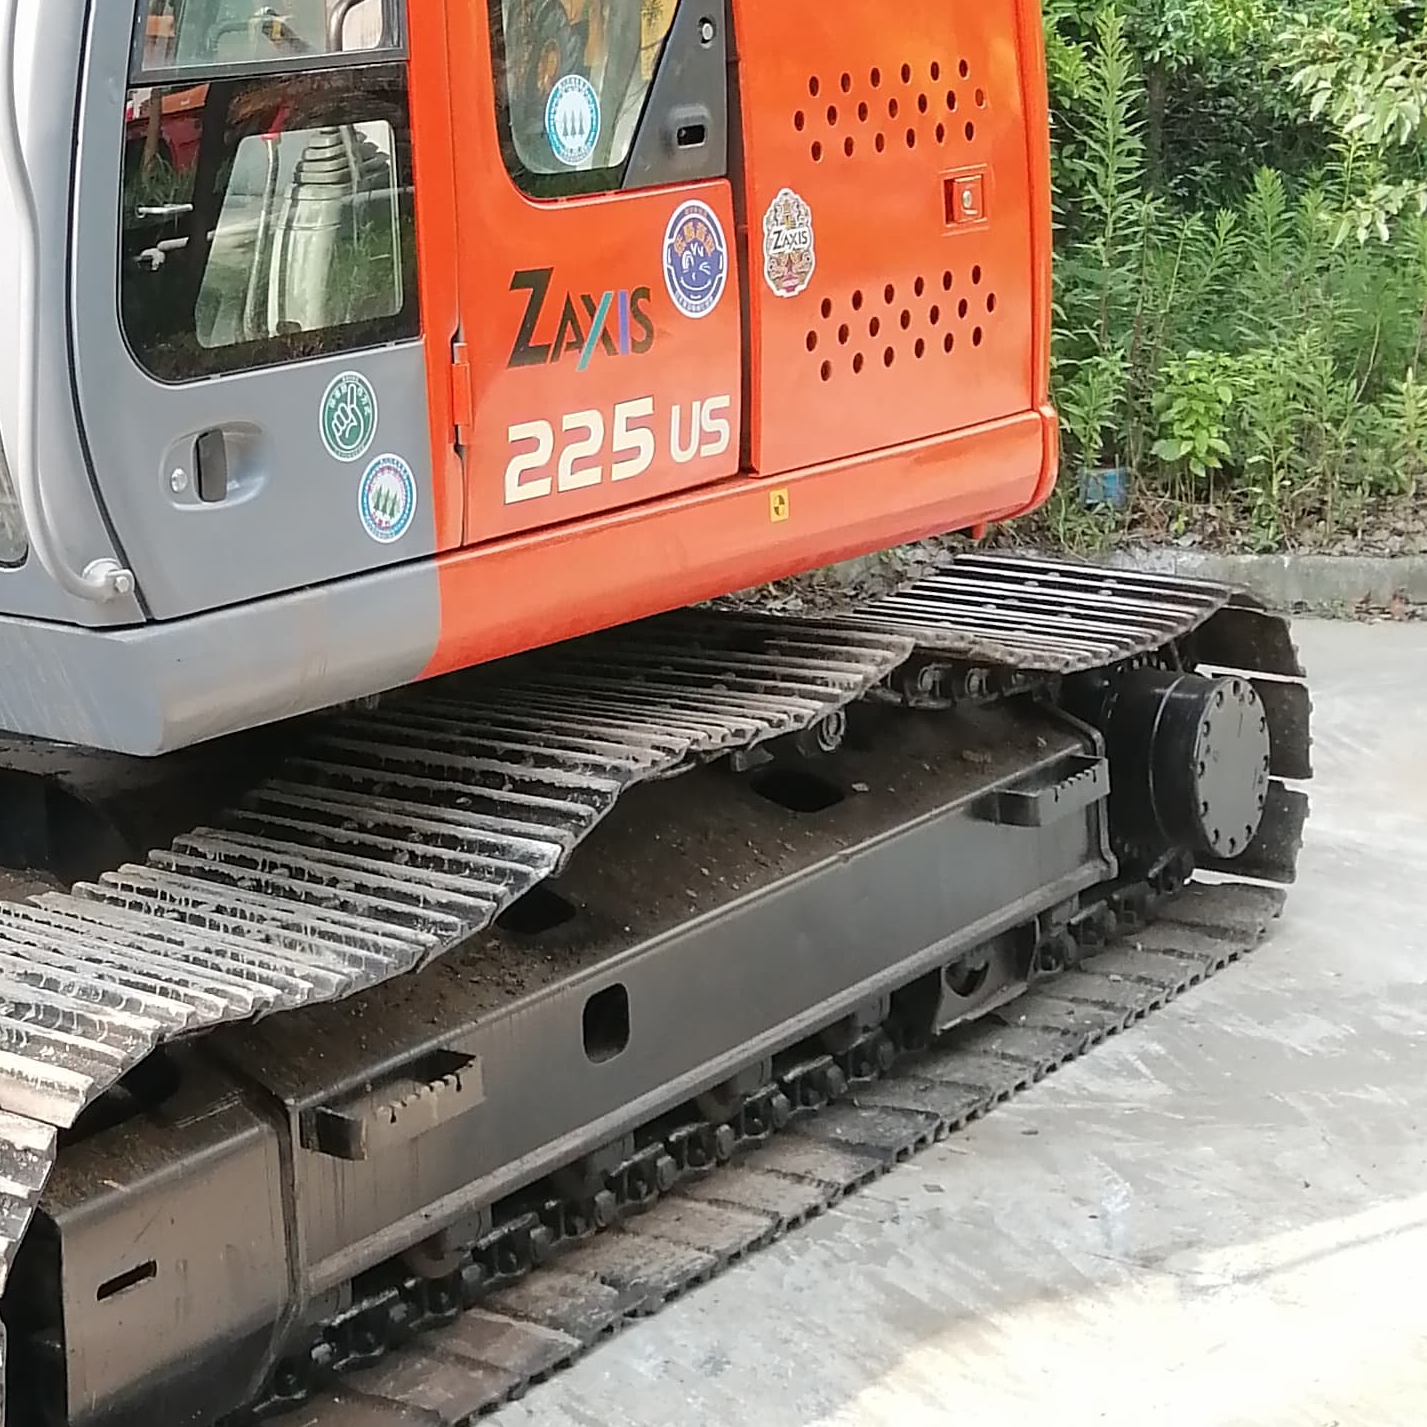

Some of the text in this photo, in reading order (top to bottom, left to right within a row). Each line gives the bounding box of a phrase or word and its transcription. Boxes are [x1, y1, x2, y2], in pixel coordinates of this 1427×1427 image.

[773, 229, 808, 250] ZAXIS
[508, 267, 654, 371] ZAXIS
[504, 394, 731, 505] 225 US
